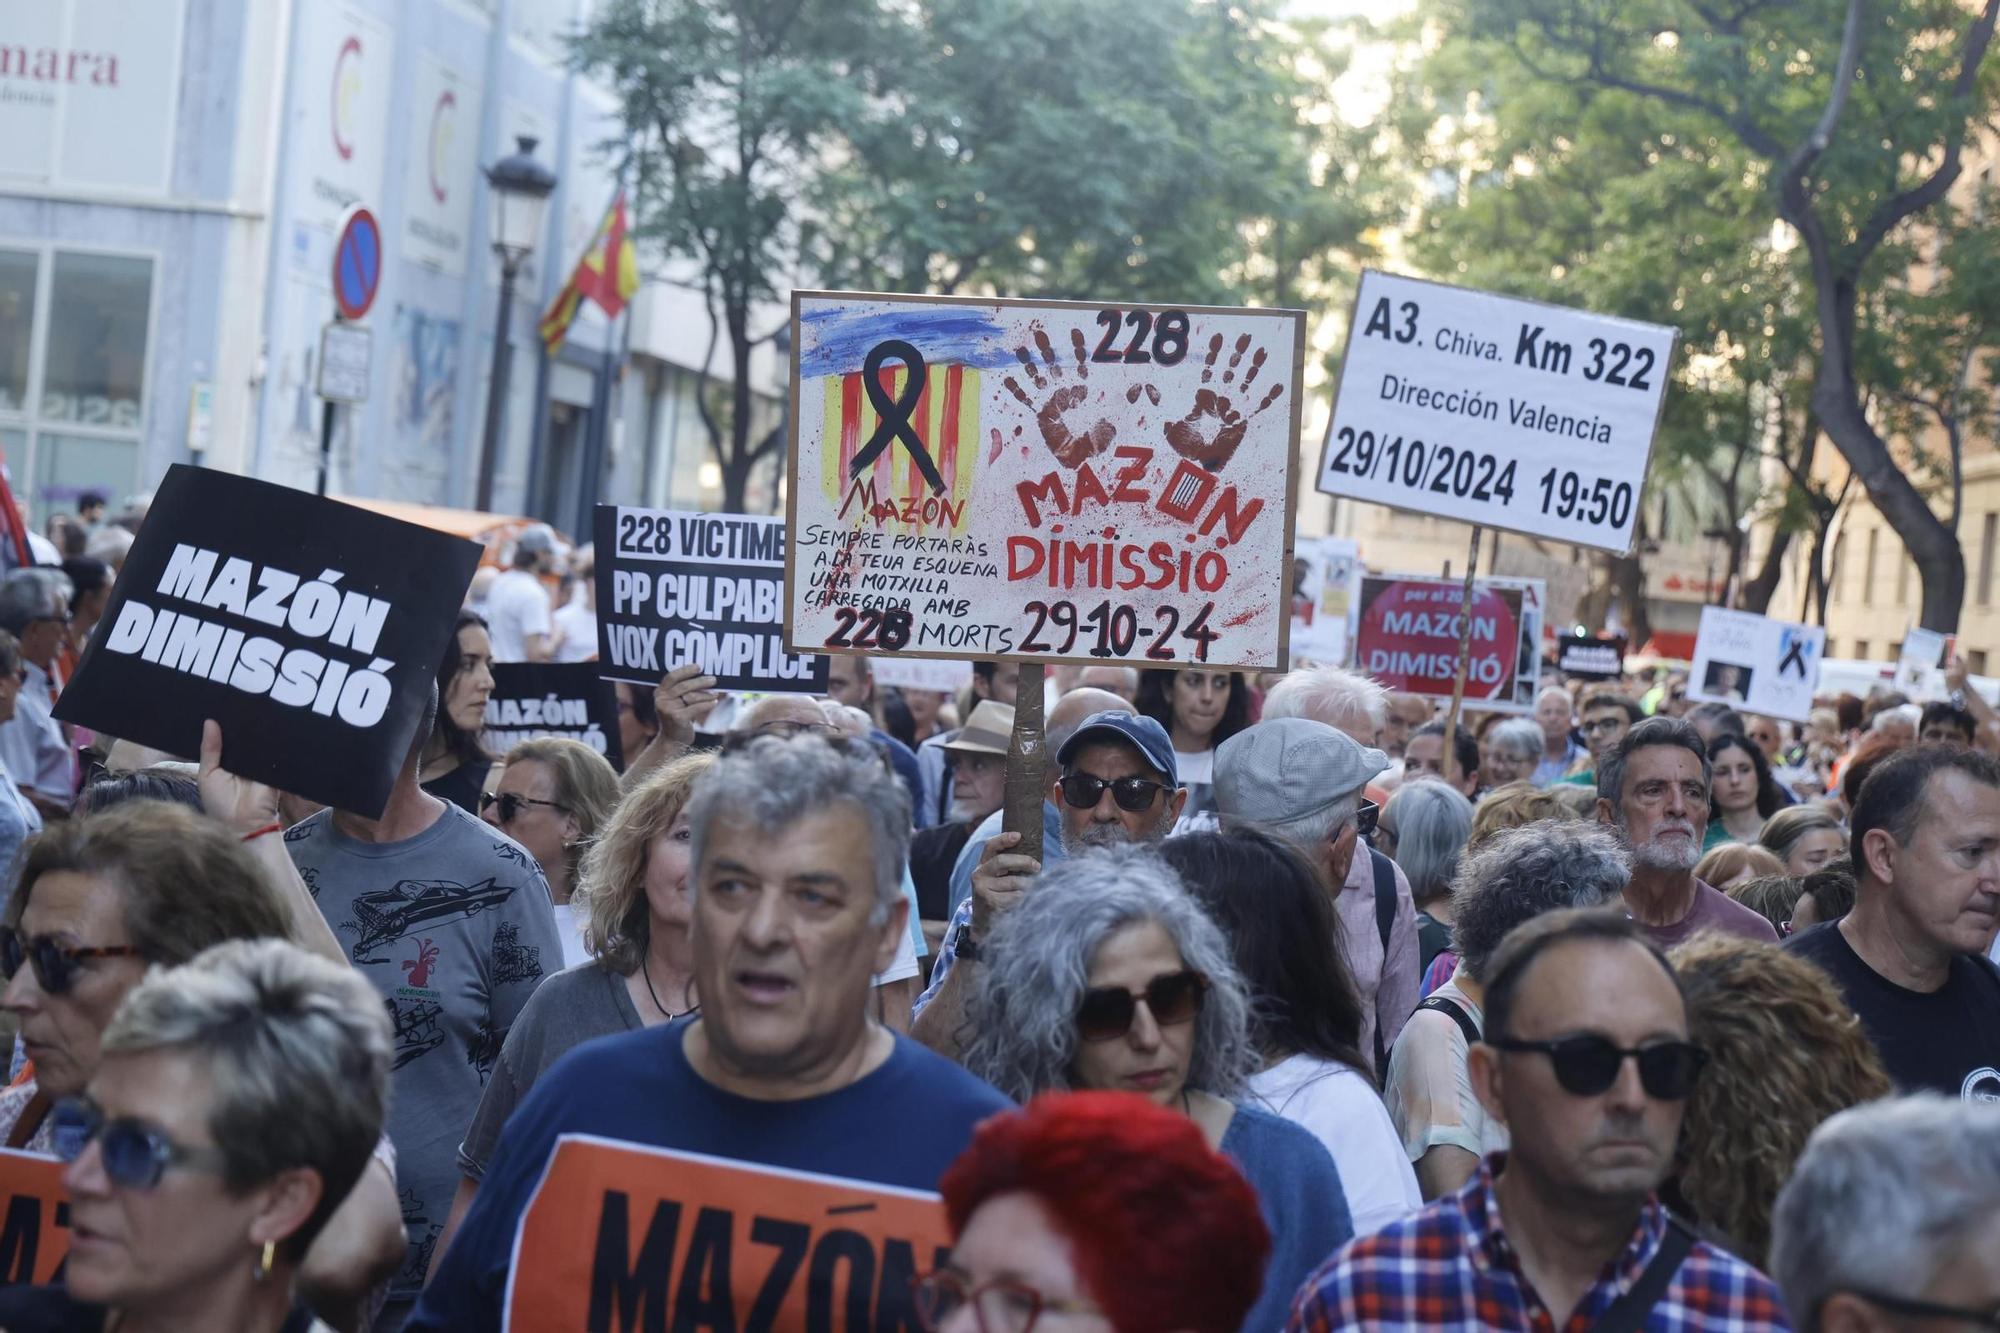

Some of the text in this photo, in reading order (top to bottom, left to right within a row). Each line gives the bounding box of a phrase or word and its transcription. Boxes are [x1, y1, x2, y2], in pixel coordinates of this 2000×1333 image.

[1090, 308, 1190, 367] 228
[1435, 328, 1503, 362] Chiva.
[1514, 323, 1572, 374] Km
[1583, 338, 1655, 391] 322
[1380, 374, 1612, 443] Dirección Valencia
[1331, 426, 1632, 529] 29/10/2024 19:50
[620, 514, 672, 555] 228
[797, 524, 884, 549] SEMPRE
[810, 571, 948, 594] UNA MOTXILLA
[860, 554, 903, 571] TEUA
[913, 557, 998, 578] ESQUENA
[156, 543, 391, 655] MAZÓN
[613, 569, 652, 616] PP
[923, 598, 971, 617] AMB
[606, 622, 660, 671] VOX
[824, 607, 1013, 654] 228 MORTS
[1017, 600, 1222, 662] 29-10-24
[105, 600, 396, 728] DIMISSIÓ
